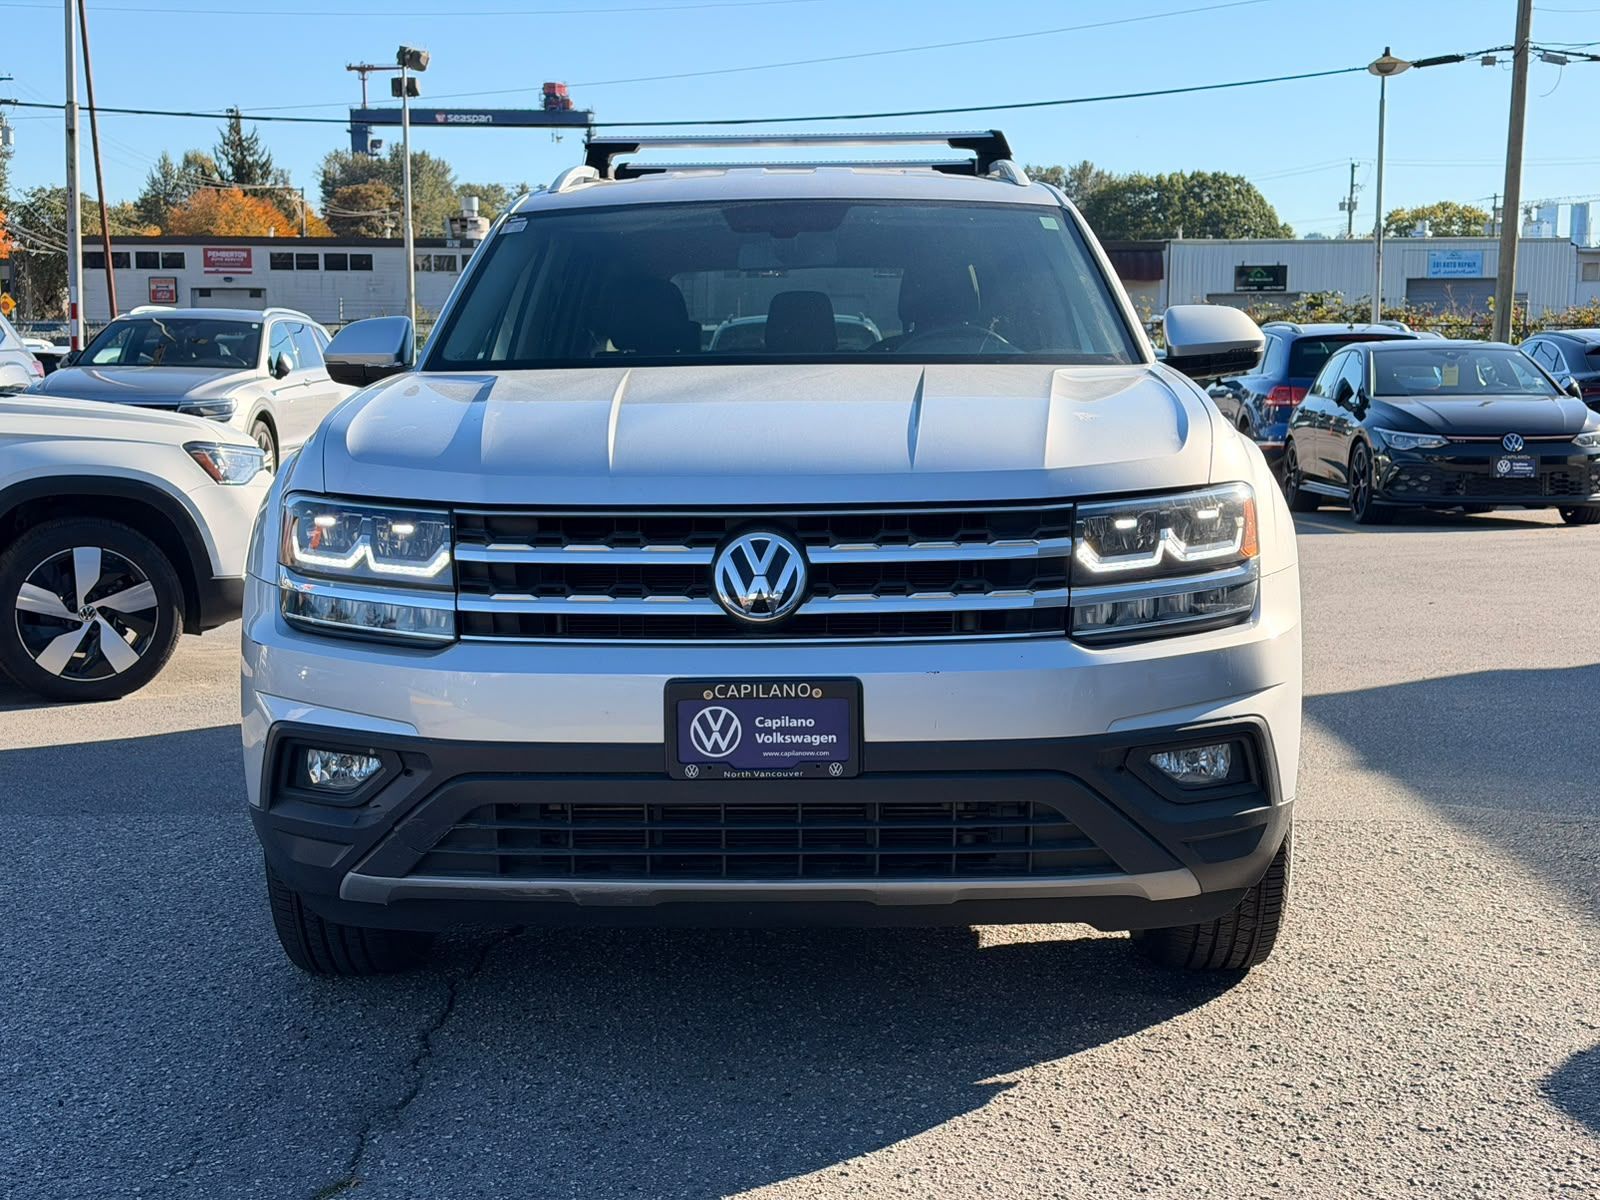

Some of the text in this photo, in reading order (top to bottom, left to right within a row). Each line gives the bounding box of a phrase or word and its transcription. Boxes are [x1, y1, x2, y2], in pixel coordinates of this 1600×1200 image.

[447, 114, 493, 123] seaspan
[1443, 261, 1457, 269] AUTO
[1458, 261, 1477, 269] REPAIR
[714, 683, 811, 699] CAPILANO
[755, 716, 815, 729] Capilano
[755, 732, 837, 745] Volkswagen
[724, 770, 804, 778] North Vancouver
